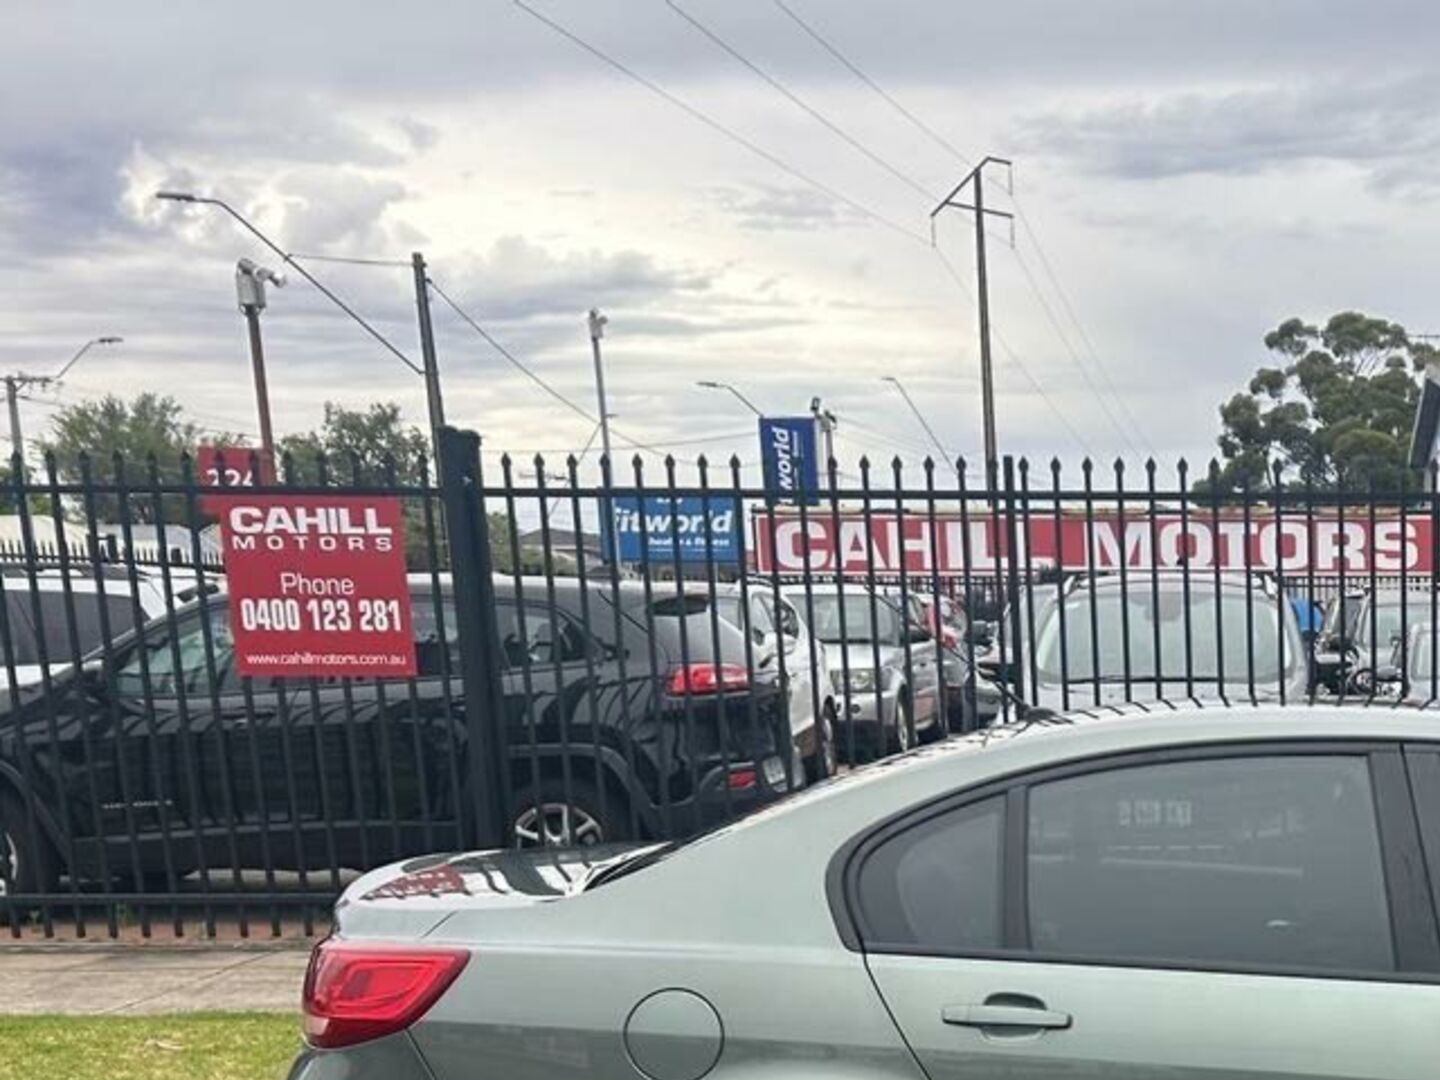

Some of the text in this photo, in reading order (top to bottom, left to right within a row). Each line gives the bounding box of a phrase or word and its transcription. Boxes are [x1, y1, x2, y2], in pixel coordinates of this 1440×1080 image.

[229, 506, 392, 534] CAHILL
[232, 536, 392, 551] MOTORS
[776, 520, 1419, 570] CAHILL MOTORS
[280, 572, 355, 595] Phone
[240, 599, 401, 632] 0400 123 281
[247, 652, 406, 665] www.cahillmotors.com.au
